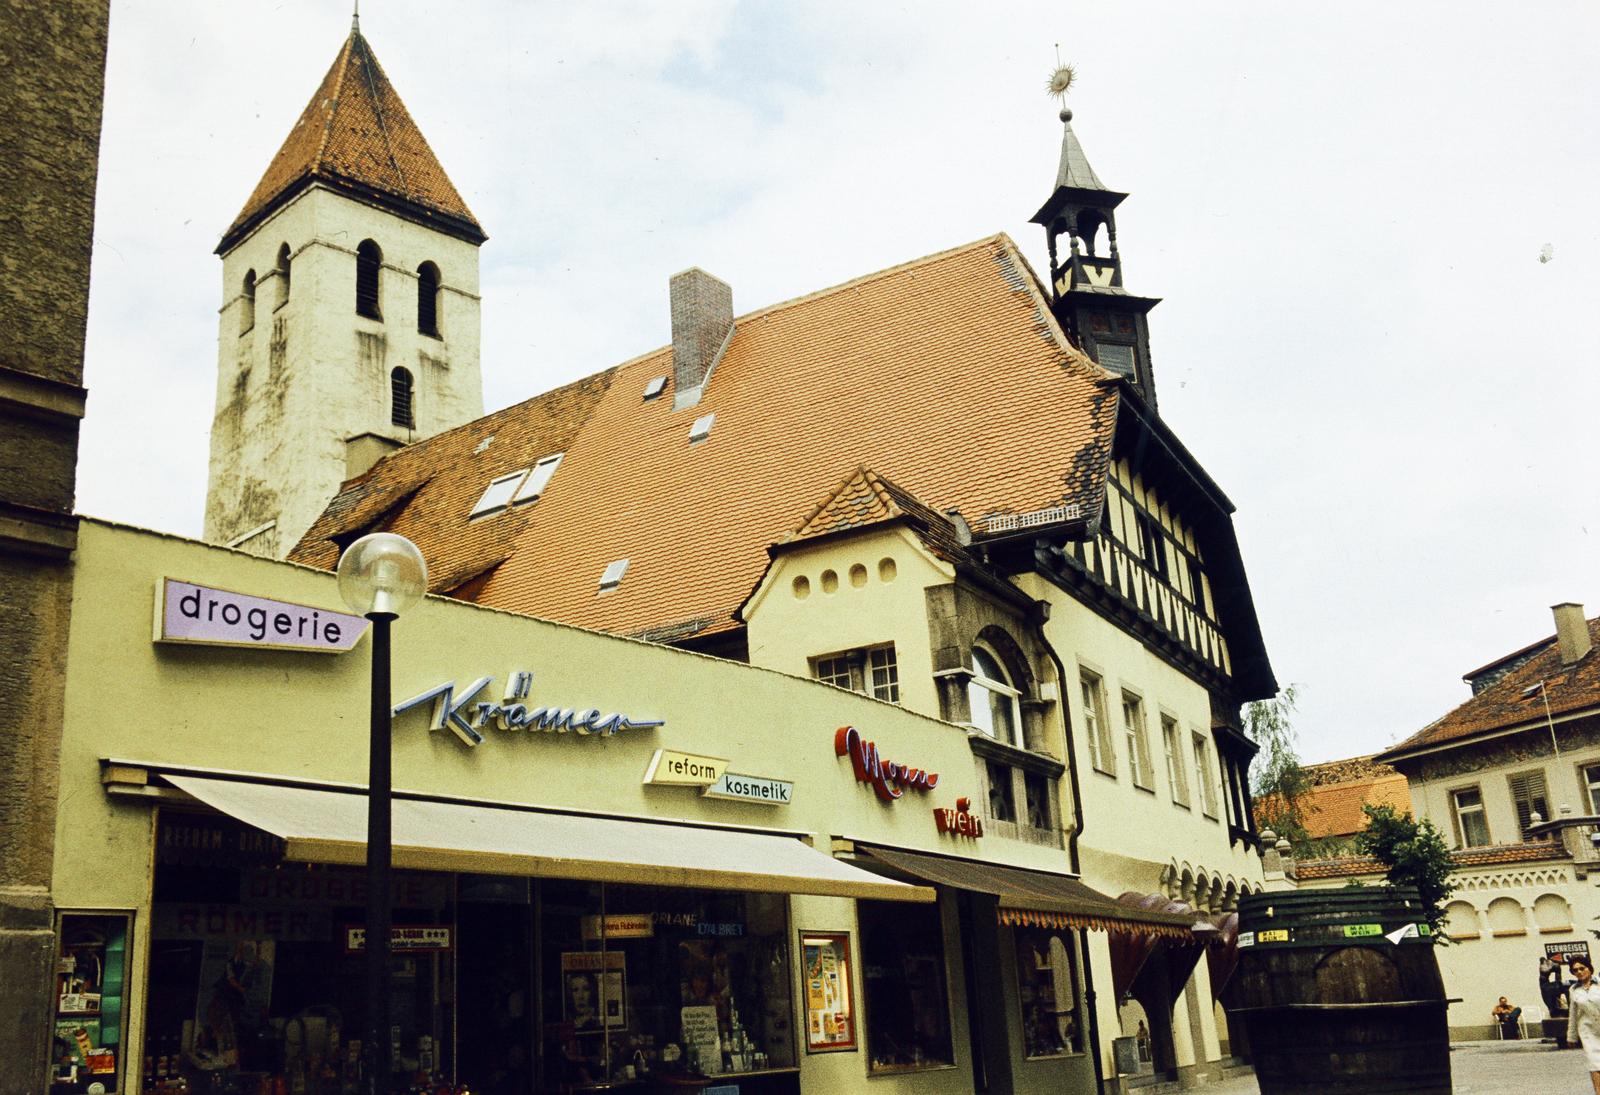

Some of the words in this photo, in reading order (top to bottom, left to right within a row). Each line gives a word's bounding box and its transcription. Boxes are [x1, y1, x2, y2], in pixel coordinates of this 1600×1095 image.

[180, 588, 342, 645] drogerie
[668, 758, 716, 780] reform
[725, 775, 788, 801] kosmetik
[932, 796, 984, 838] wein
[1546, 943, 1587, 953] FERNREISEN
